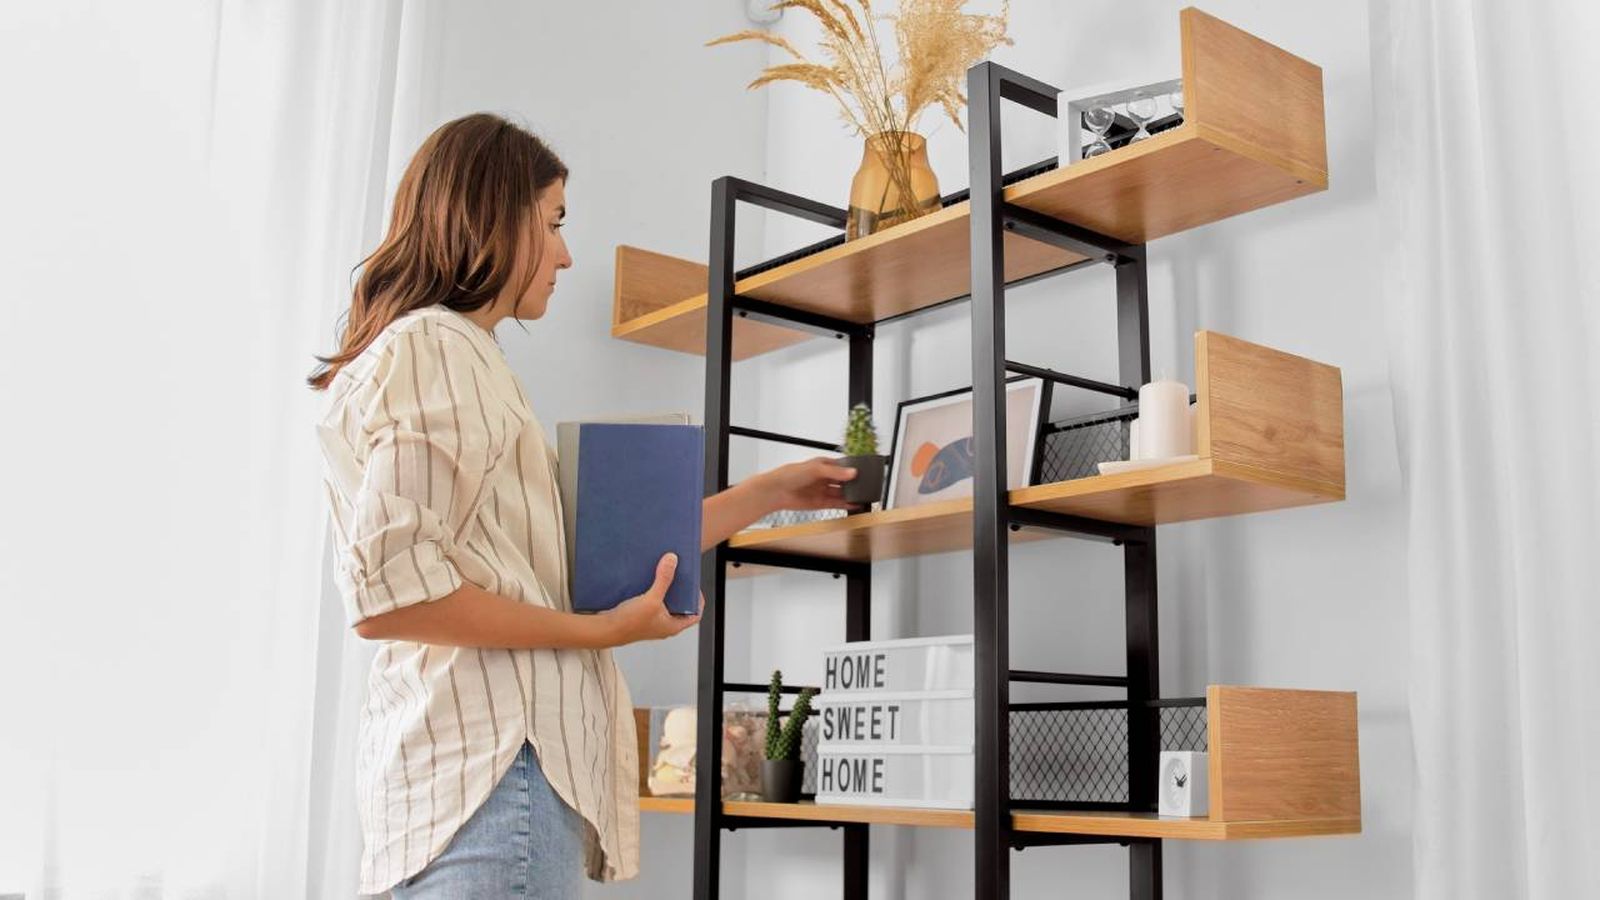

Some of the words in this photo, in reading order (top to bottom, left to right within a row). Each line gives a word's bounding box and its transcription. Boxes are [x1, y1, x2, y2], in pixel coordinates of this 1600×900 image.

[825, 654, 886, 690] HOME
[823, 705, 900, 741] SWEET
[822, 758, 884, 793] HOME
